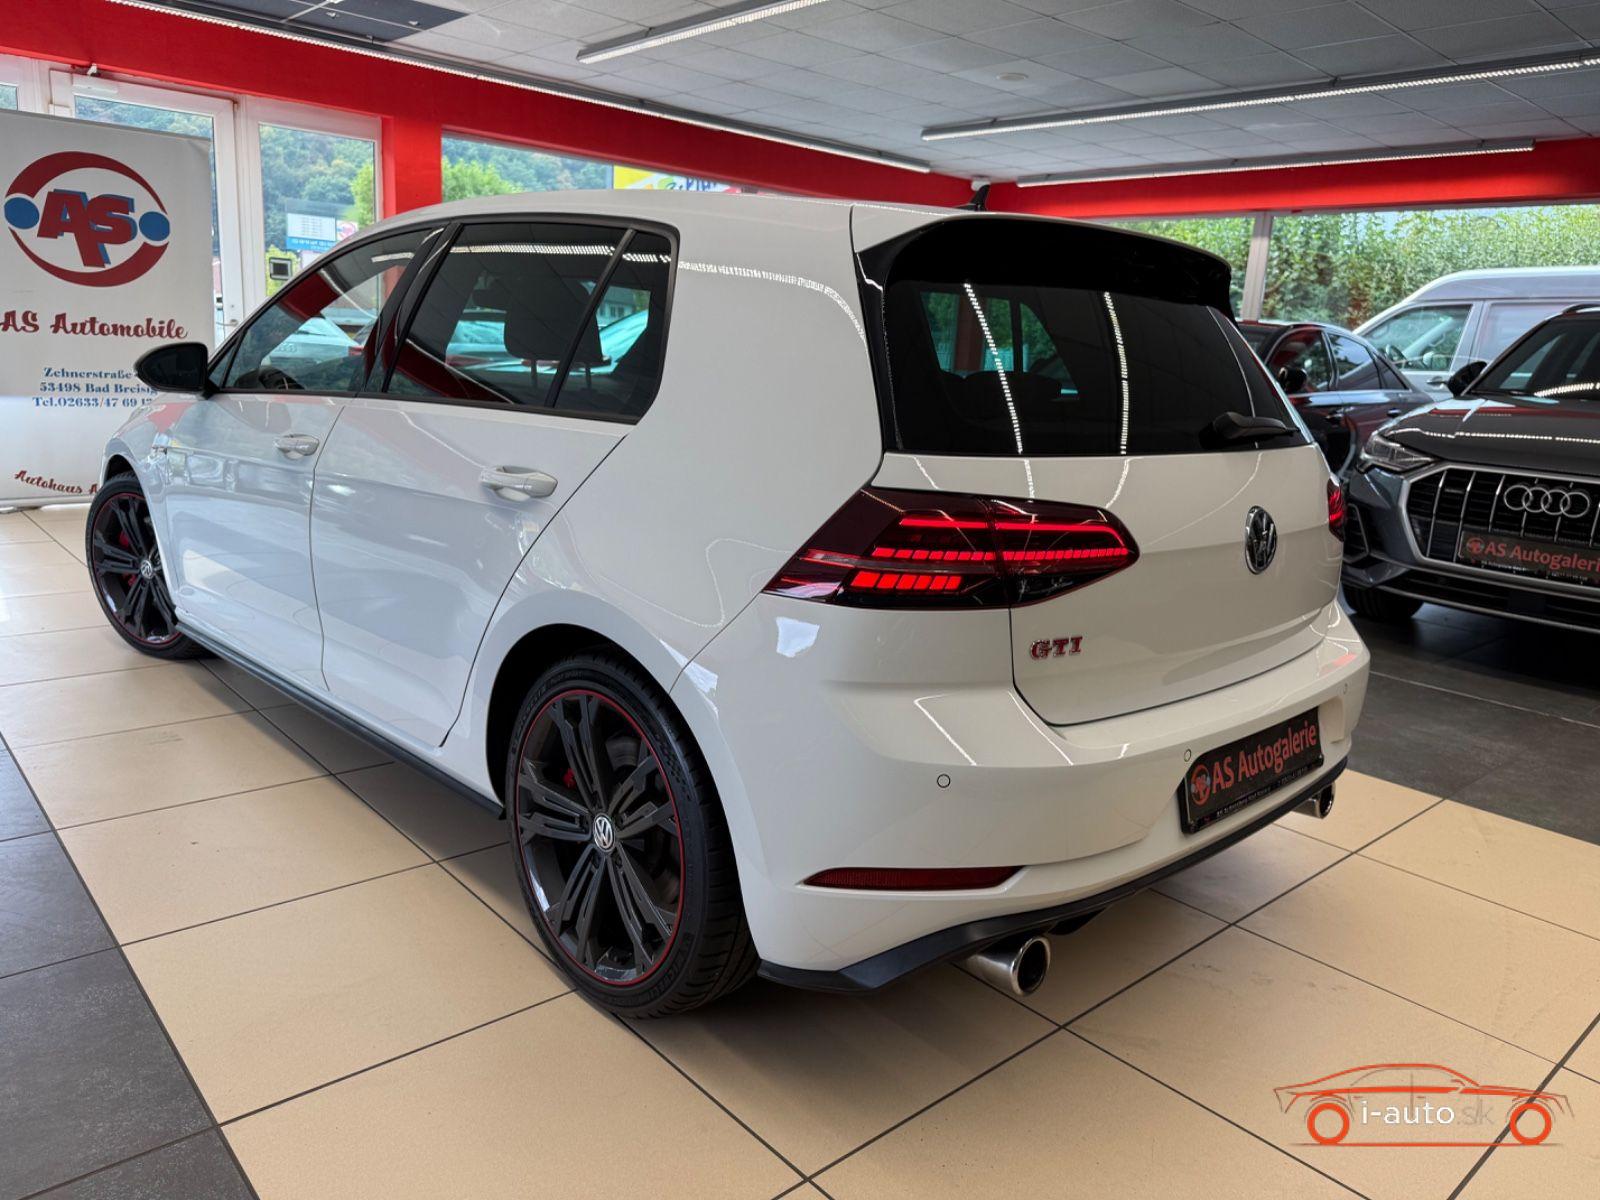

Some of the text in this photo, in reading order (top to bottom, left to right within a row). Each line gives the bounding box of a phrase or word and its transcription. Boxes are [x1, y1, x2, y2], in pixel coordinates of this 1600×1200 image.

[37, 189, 138, 268] AS
[0, 310, 188, 339] AS Automobile
[44, 367, 131, 379] Zehnerstraße
[40, 382, 81, 392] 53498
[85, 383, 109, 393] Bad
[122, 398, 137, 407] 69
[15, 470, 82, 493] Autohaus
[1484, 542, 1507, 558] AS
[1030, 636, 1083, 660] GTI
[1212, 756, 1234, 794] AS
[1238, 720, 1317, 774] Autogalerie
